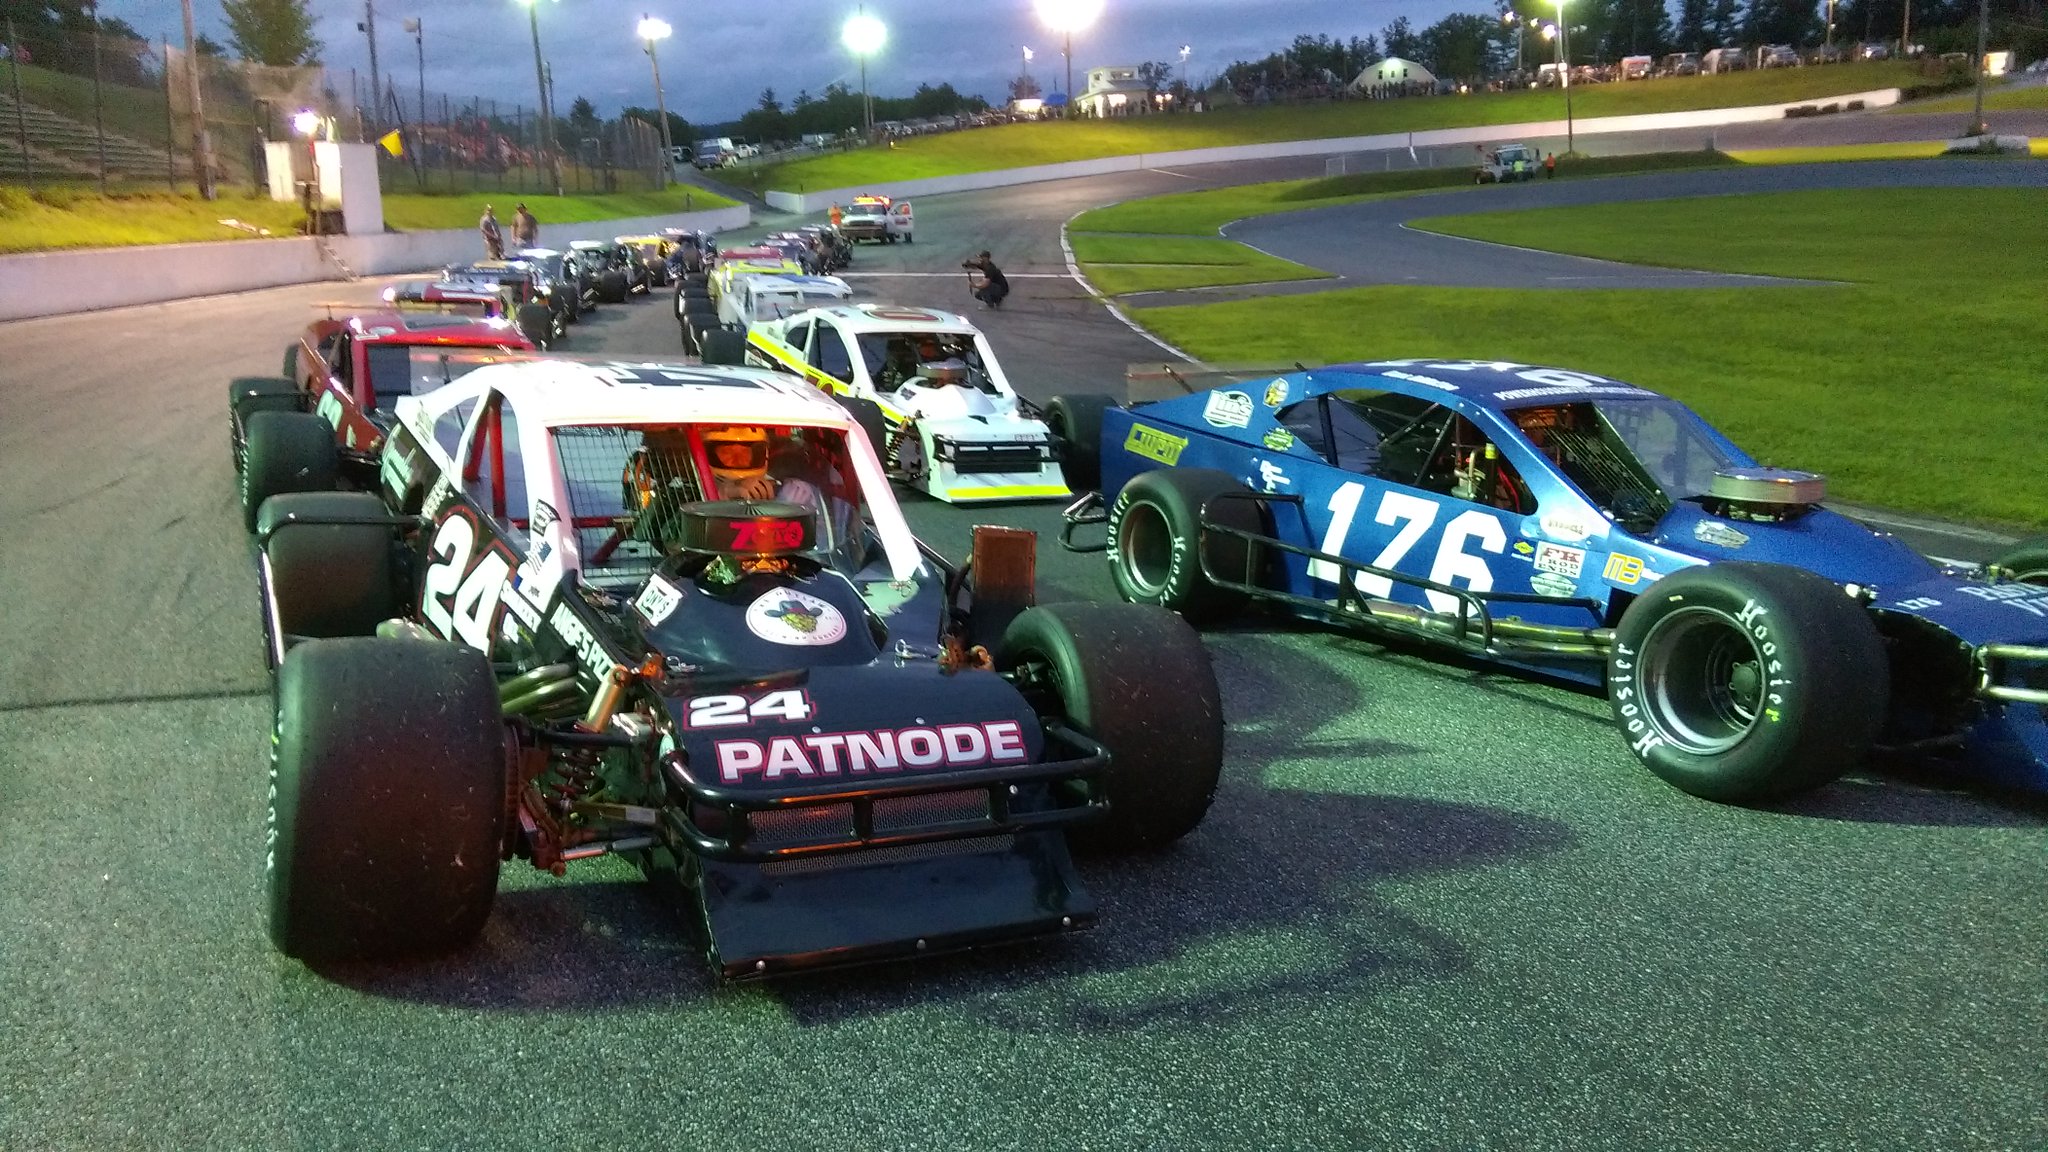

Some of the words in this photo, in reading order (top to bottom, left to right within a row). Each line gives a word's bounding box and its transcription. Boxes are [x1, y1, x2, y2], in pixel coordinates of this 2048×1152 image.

[1307, 481, 1507, 617] 176
[1542, 547, 1580, 564] FK
[1548, 559, 1578, 570] ROD
[421, 514, 510, 657] 24
[1538, 563, 1577, 576] ENDS
[1896, 597, 1942, 610] 176
[688, 689, 812, 728] 24
[1610, 643, 1665, 757] Hoosier
[717, 721, 1025, 781] PATNODE
